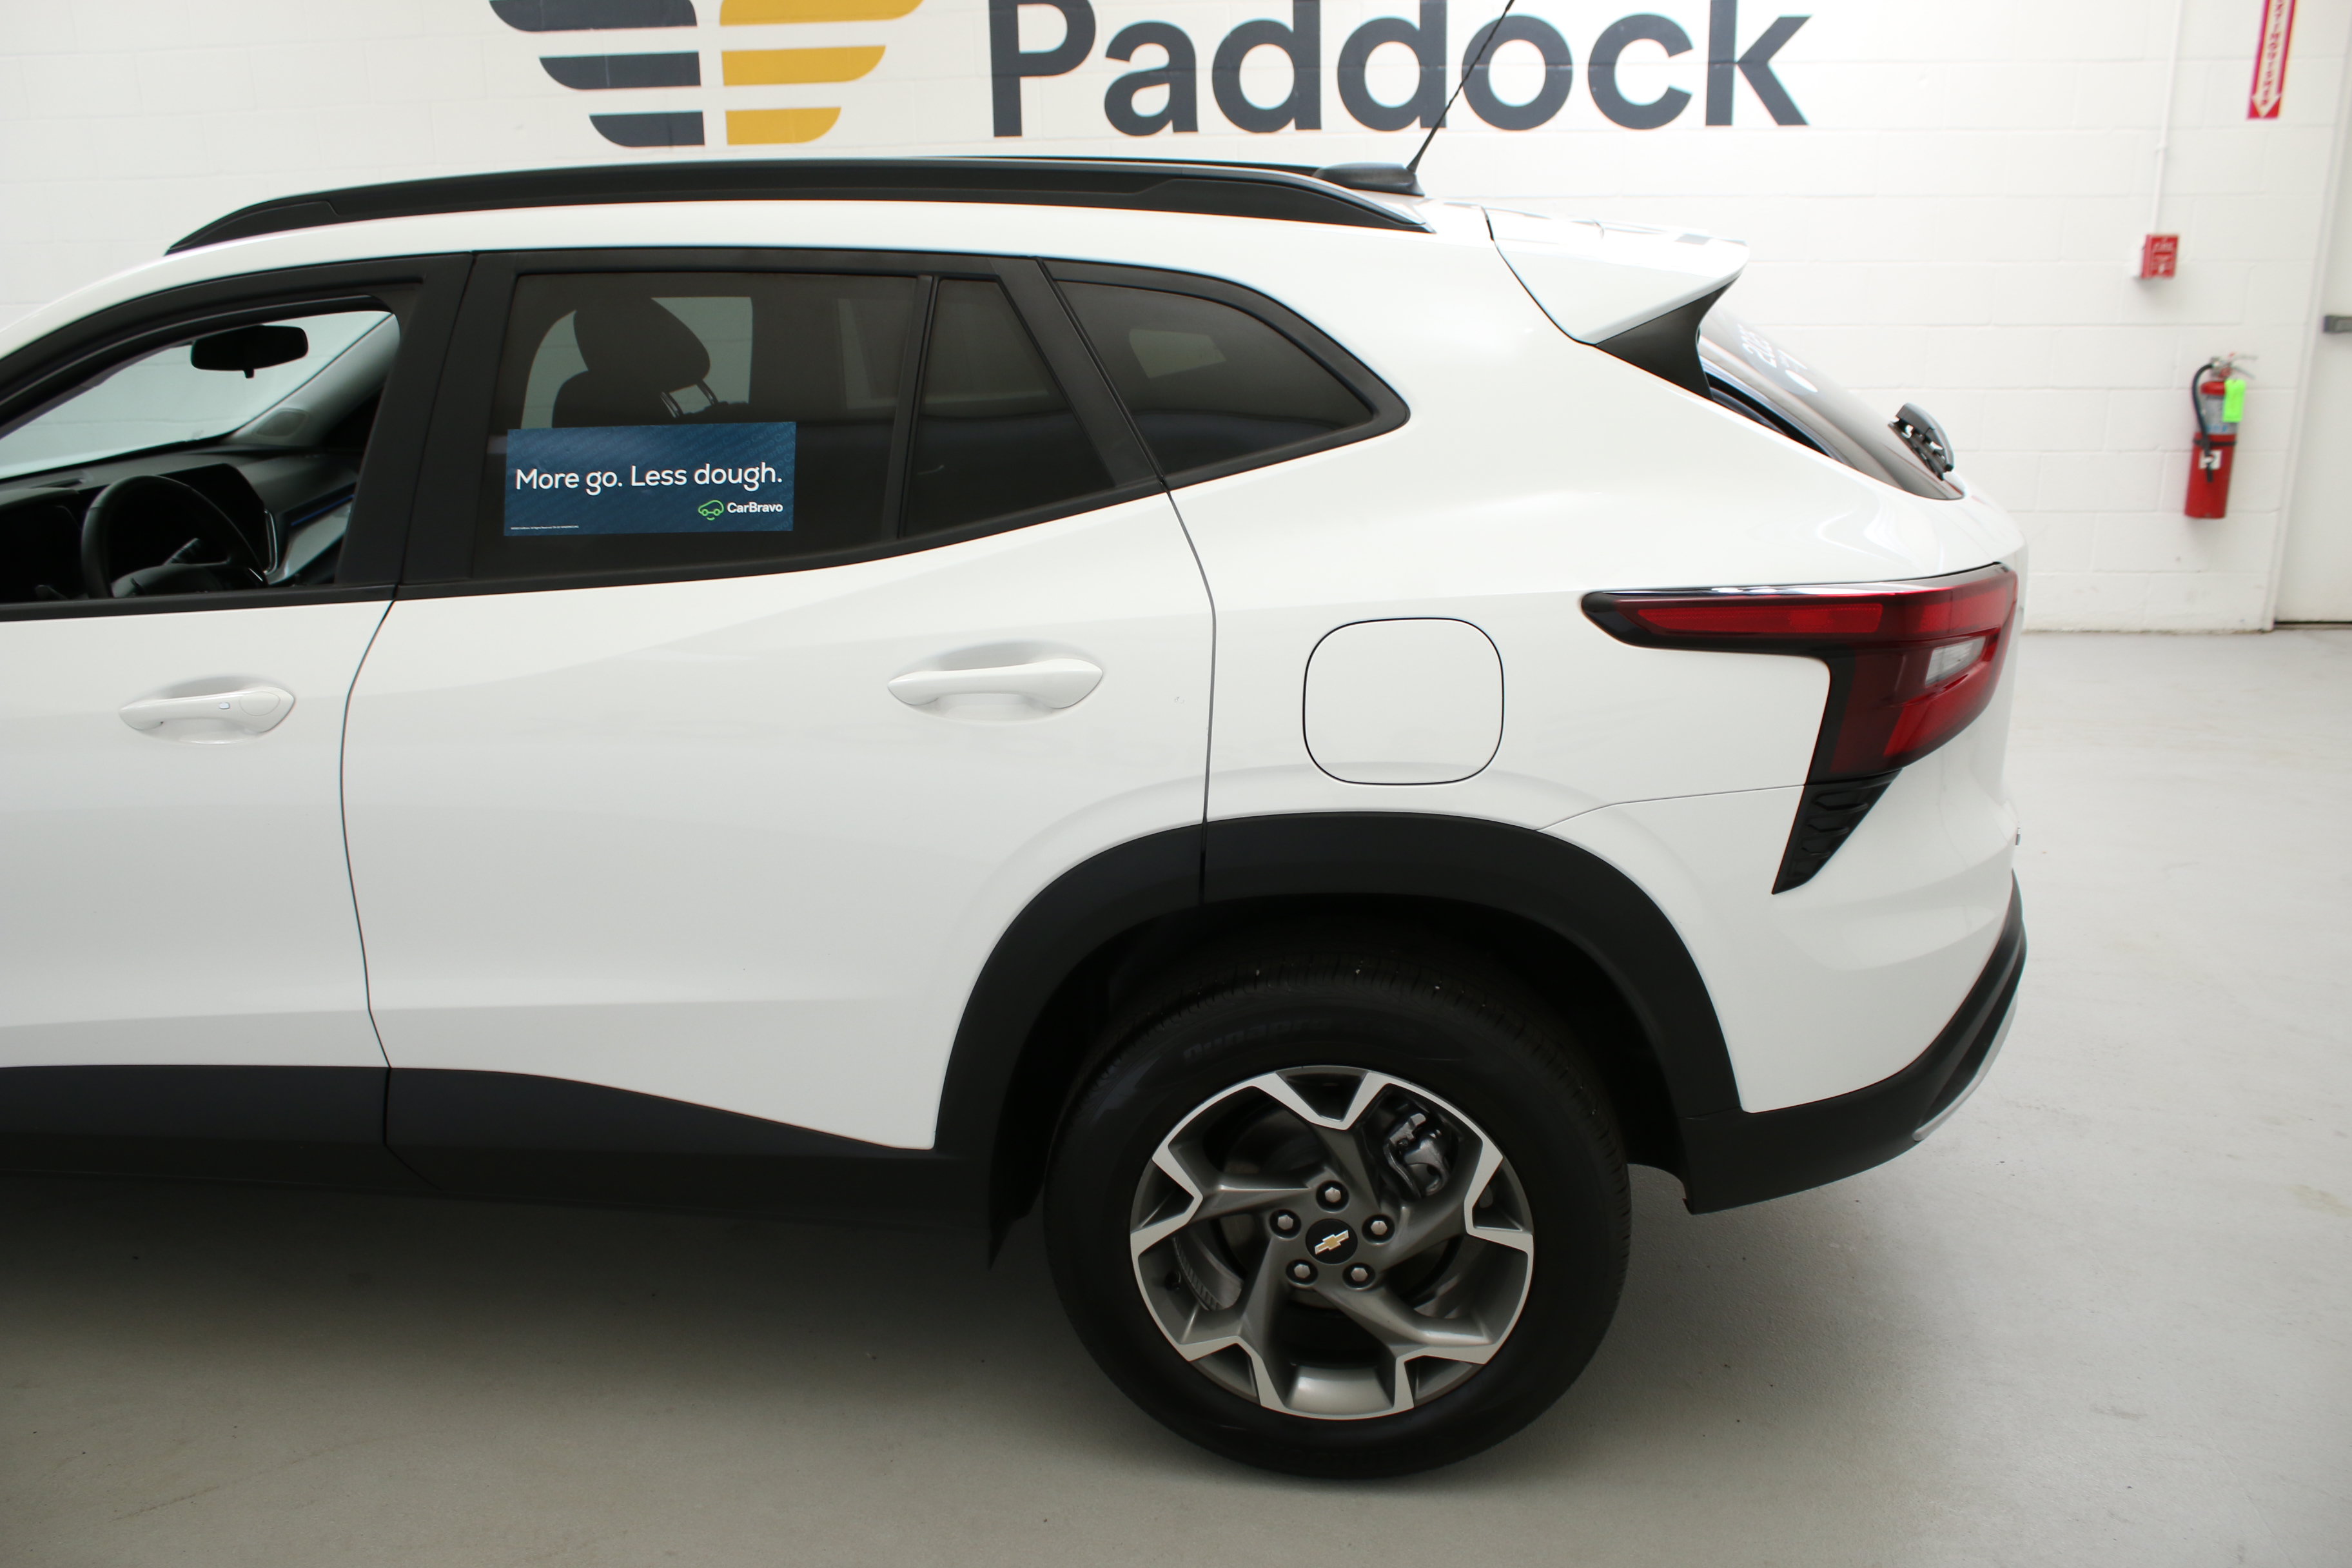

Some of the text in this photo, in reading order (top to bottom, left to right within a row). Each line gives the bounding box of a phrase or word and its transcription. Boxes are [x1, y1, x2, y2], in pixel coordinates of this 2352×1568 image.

[989, 0, 1813, 137] Paddock
[516, 462, 783, 496] More go. Less dough.
[727, 502, 784, 514] CarBravo
